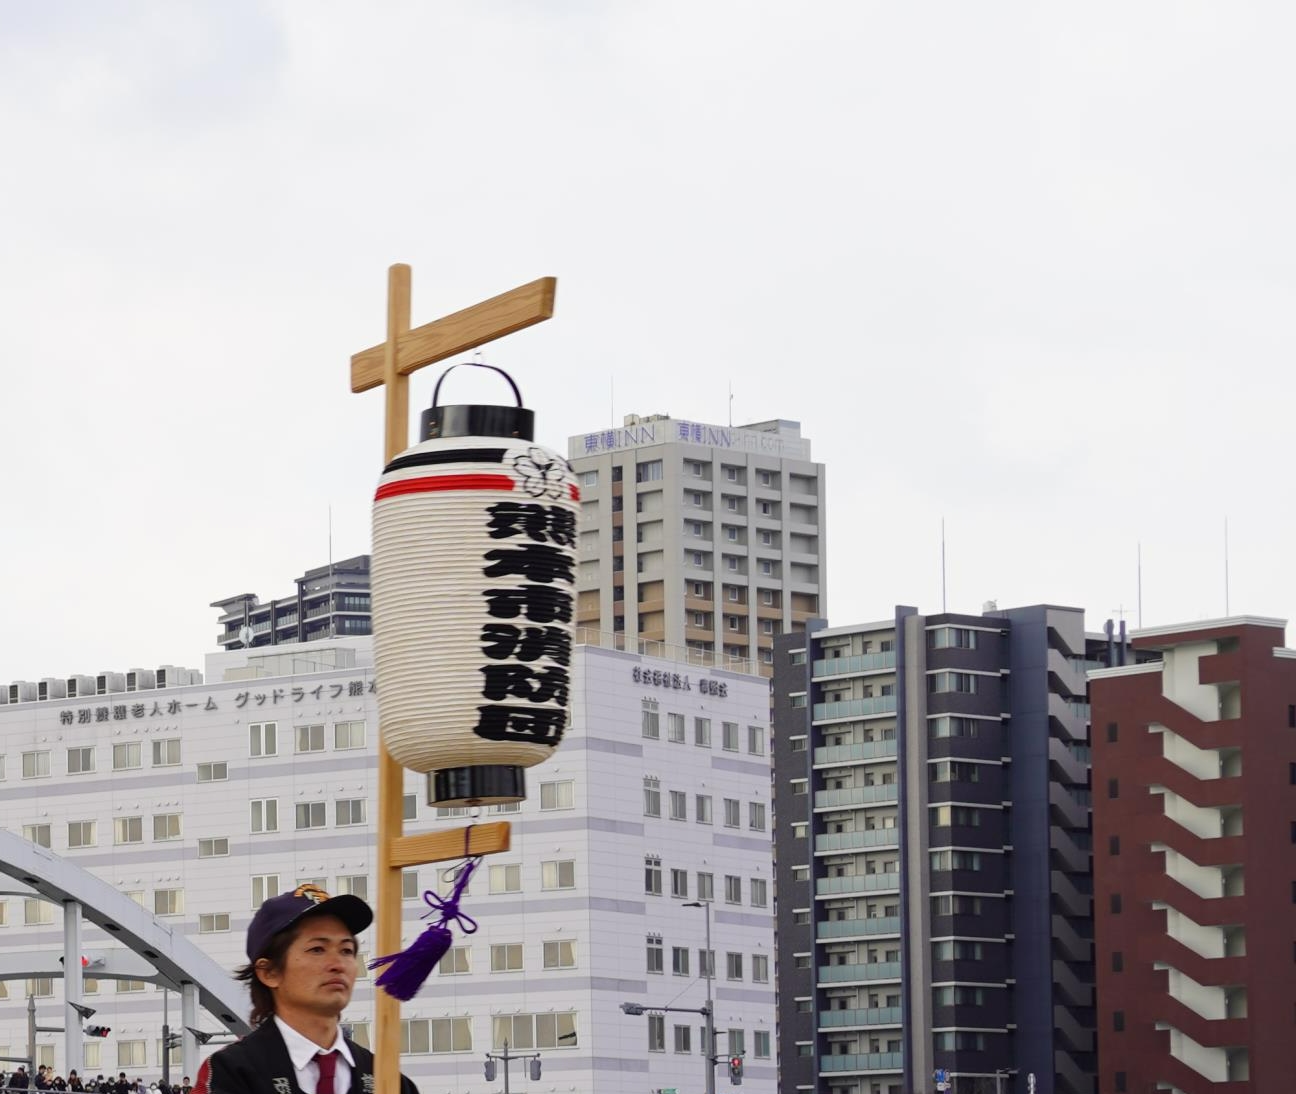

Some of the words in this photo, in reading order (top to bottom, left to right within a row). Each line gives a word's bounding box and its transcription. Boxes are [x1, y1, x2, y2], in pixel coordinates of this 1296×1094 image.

[59, 695, 219, 725] 特別養護老人ホーム
